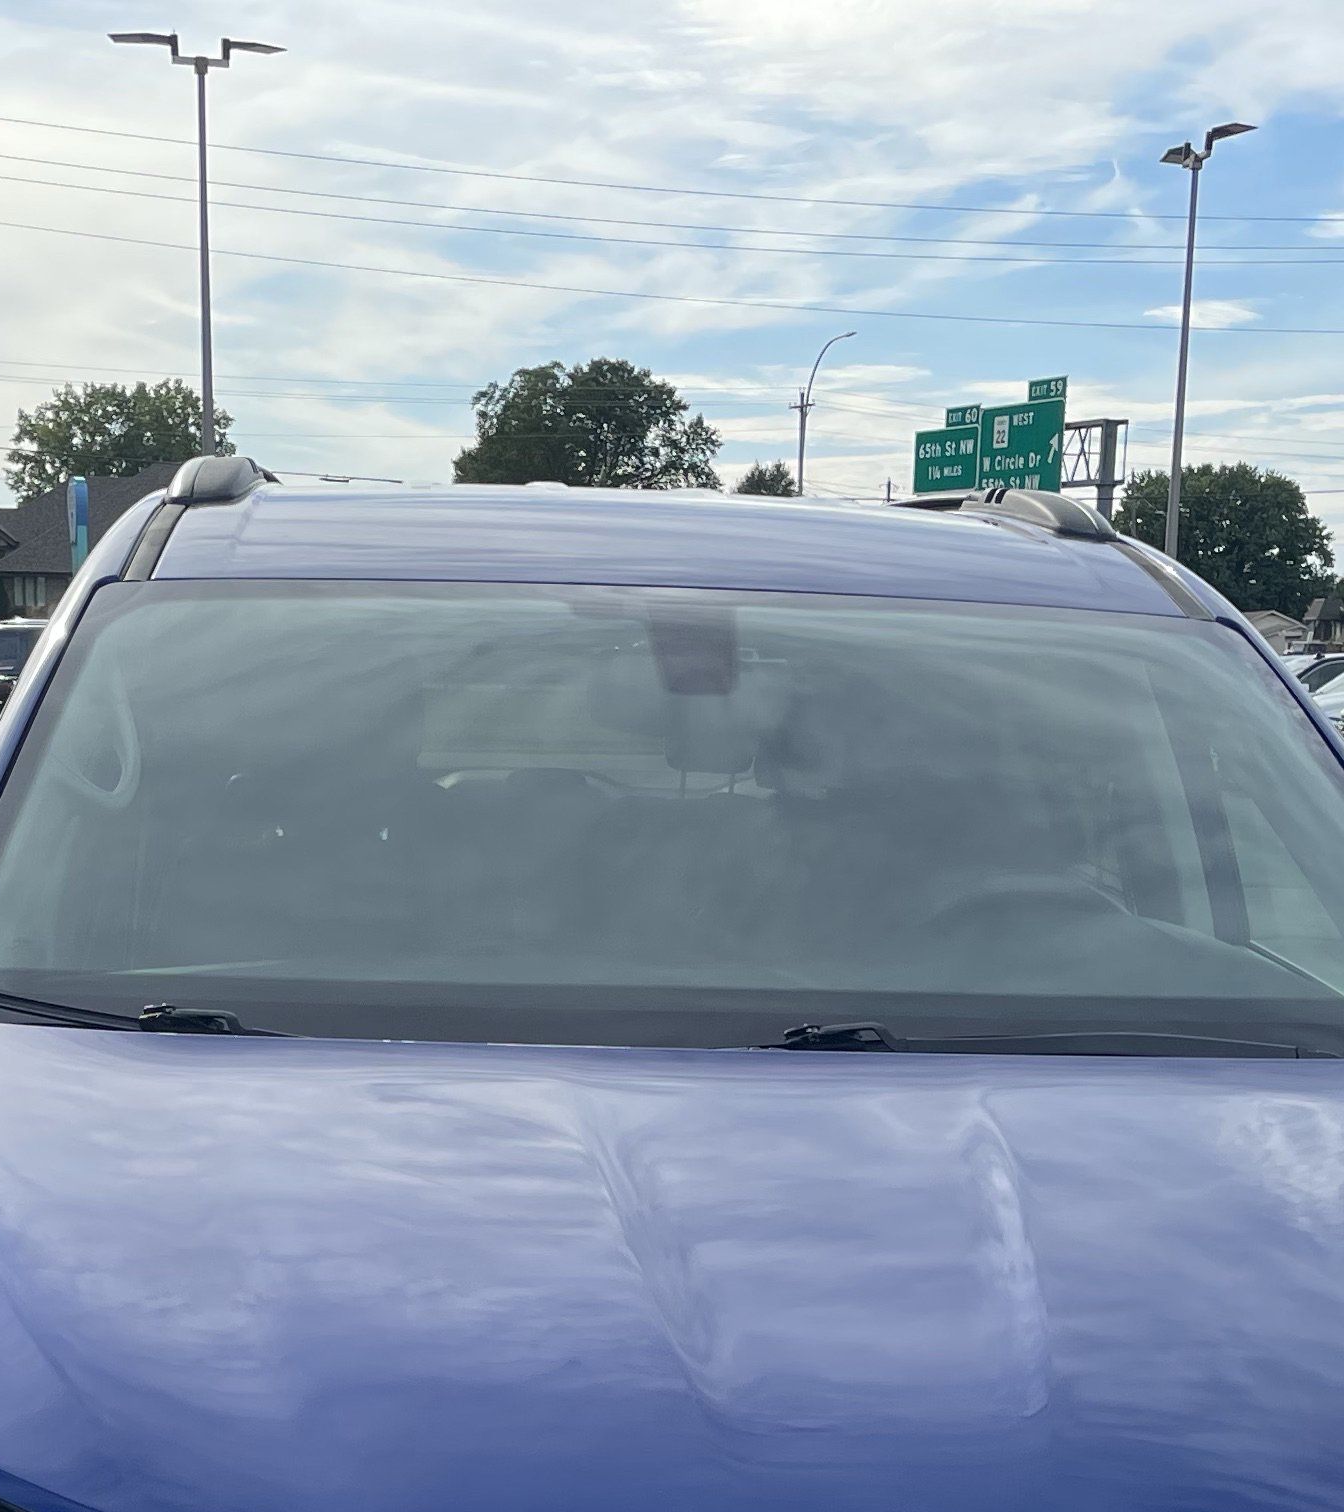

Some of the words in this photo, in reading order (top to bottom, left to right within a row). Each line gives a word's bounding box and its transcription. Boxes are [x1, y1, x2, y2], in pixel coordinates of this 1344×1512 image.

[1031, 384, 1047, 397] EXIT
[1049, 380, 1063, 396] 59
[948, 412, 962, 423] EXIT
[965, 408, 977, 423] 60
[1013, 412, 1034, 426] WEST
[996, 429, 1006, 444] 22
[919, 442, 942, 459] 65th
[945, 441, 956, 456] St
[959, 439, 974, 455] NW
[982, 456, 991, 472] W
[995, 454, 1025, 470] Circle
[1029, 452, 1041, 468] Dr
[943, 465, 962, 477] MILES
[1009, 476, 1020, 489] St
[1025, 474, 1040, 490] NW
